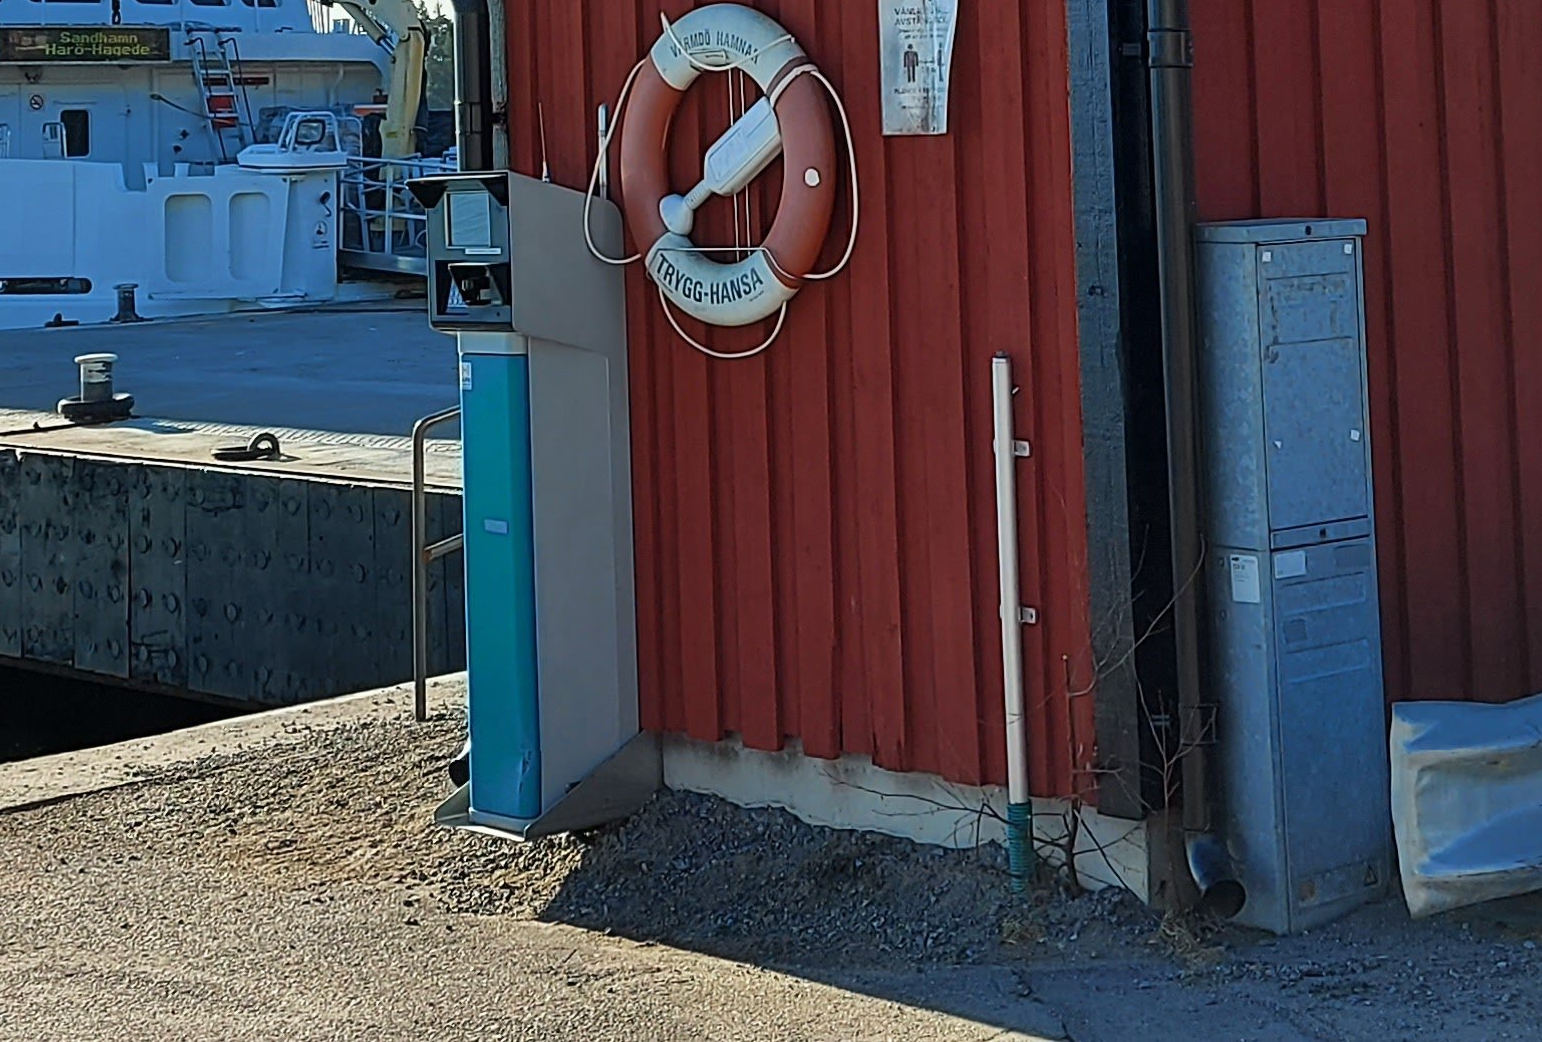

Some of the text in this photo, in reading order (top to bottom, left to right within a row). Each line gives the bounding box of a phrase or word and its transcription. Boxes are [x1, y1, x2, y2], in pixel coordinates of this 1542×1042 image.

[59, 31, 138, 44] Sandhamn
[44, 43, 151, 56] Harö-Hagede
[656, 253, 764, 305] TRYGG-HANSA
